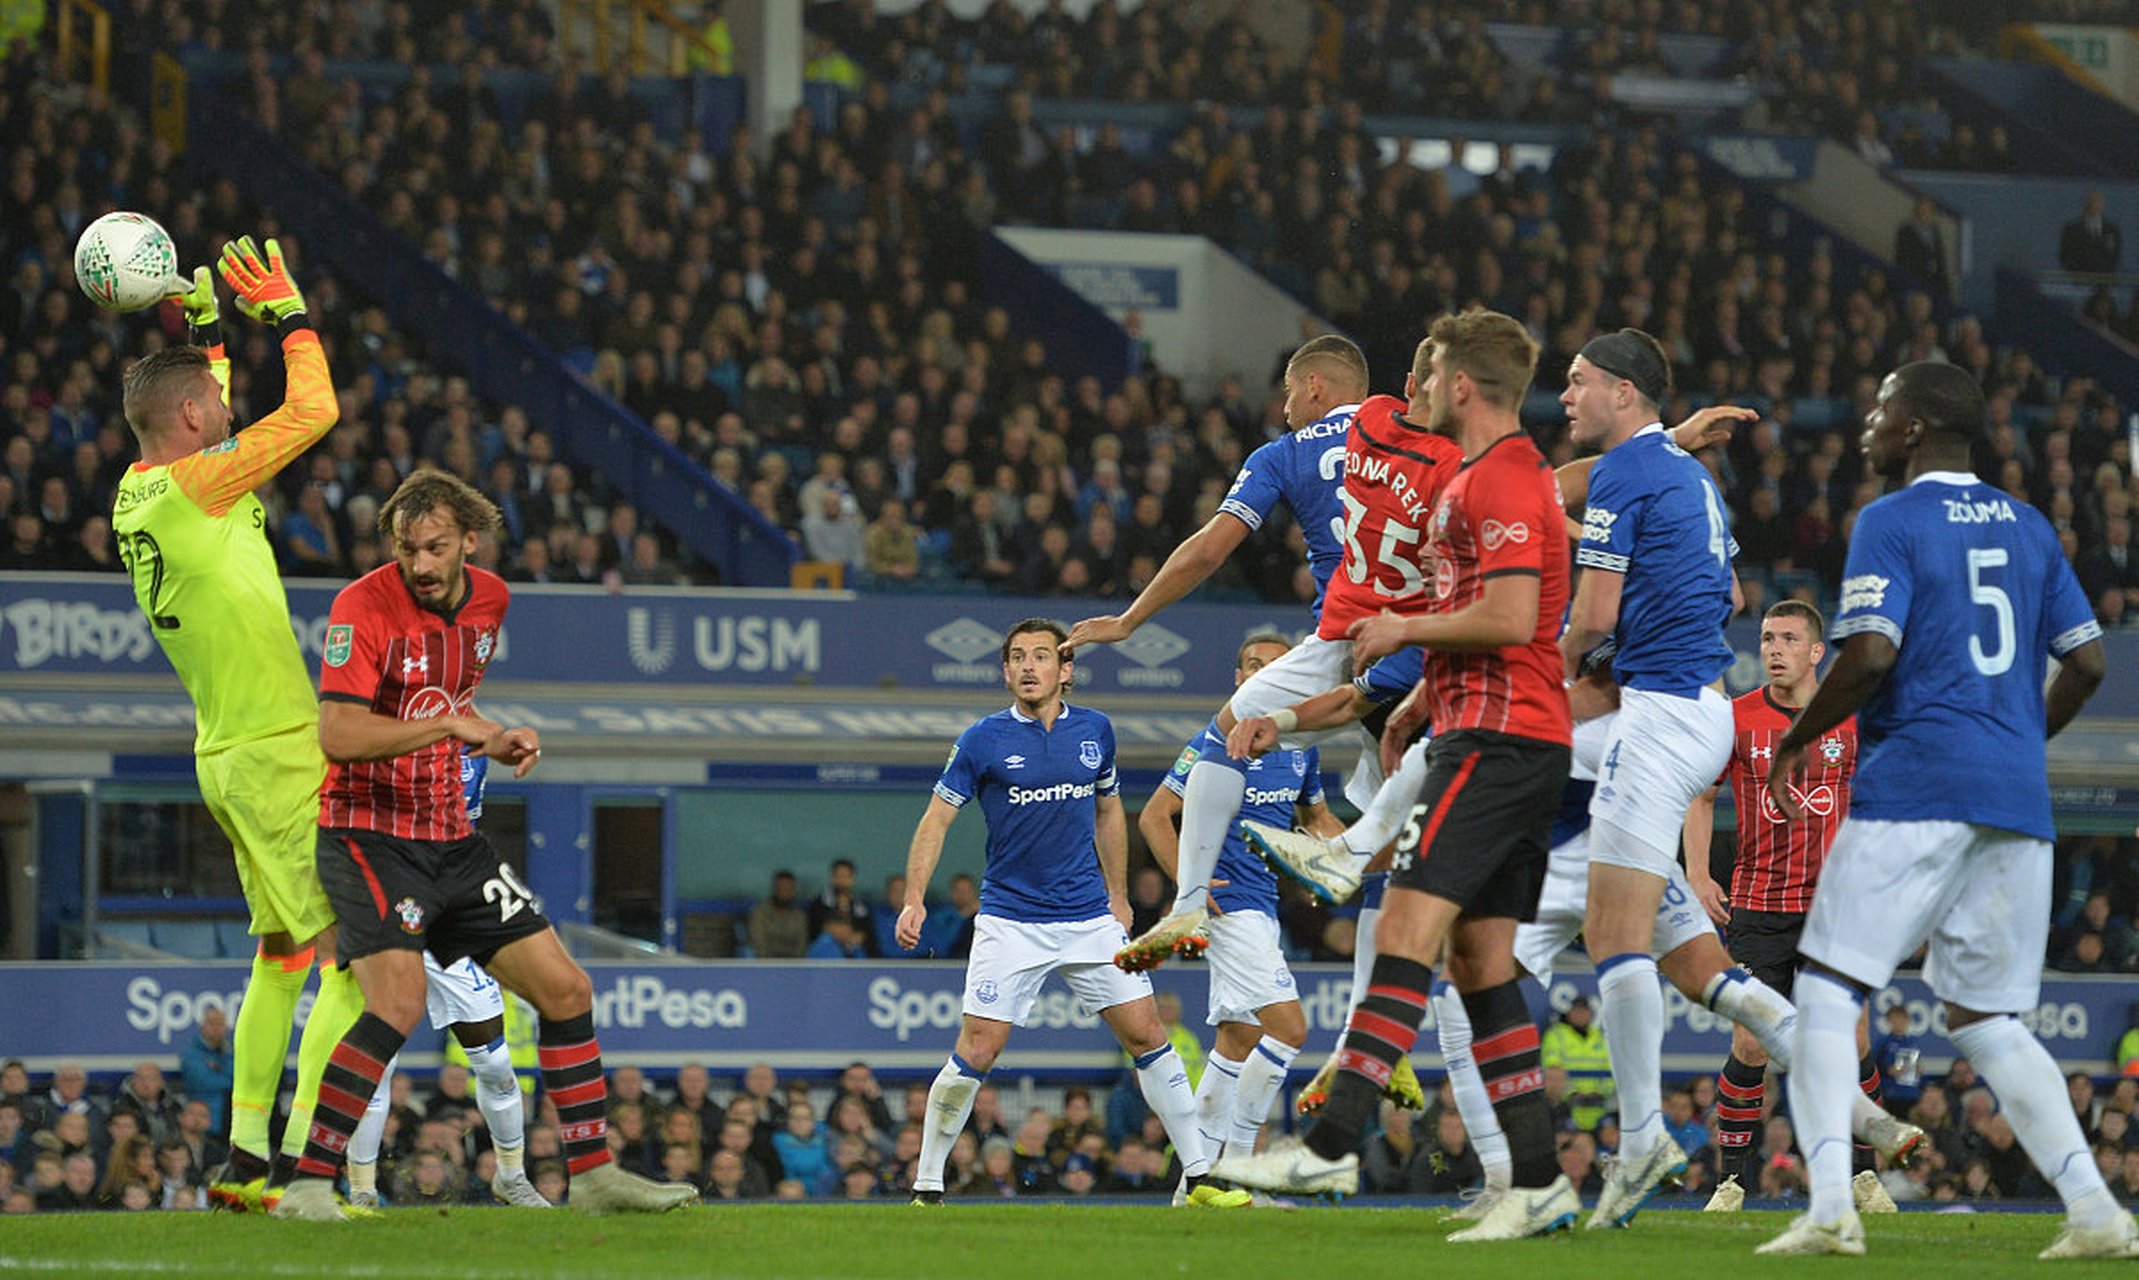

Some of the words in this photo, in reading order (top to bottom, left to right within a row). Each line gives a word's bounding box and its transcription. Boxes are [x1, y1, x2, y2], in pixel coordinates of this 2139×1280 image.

[1344, 487, 1426, 600] 35
[1942, 499, 2017, 524] ZOUMA
[5, 597, 153, 668] BIRDS
[693, 614, 822, 673] USM
[1967, 547, 2017, 677] 5
[1397, 803, 1429, 852] 5
